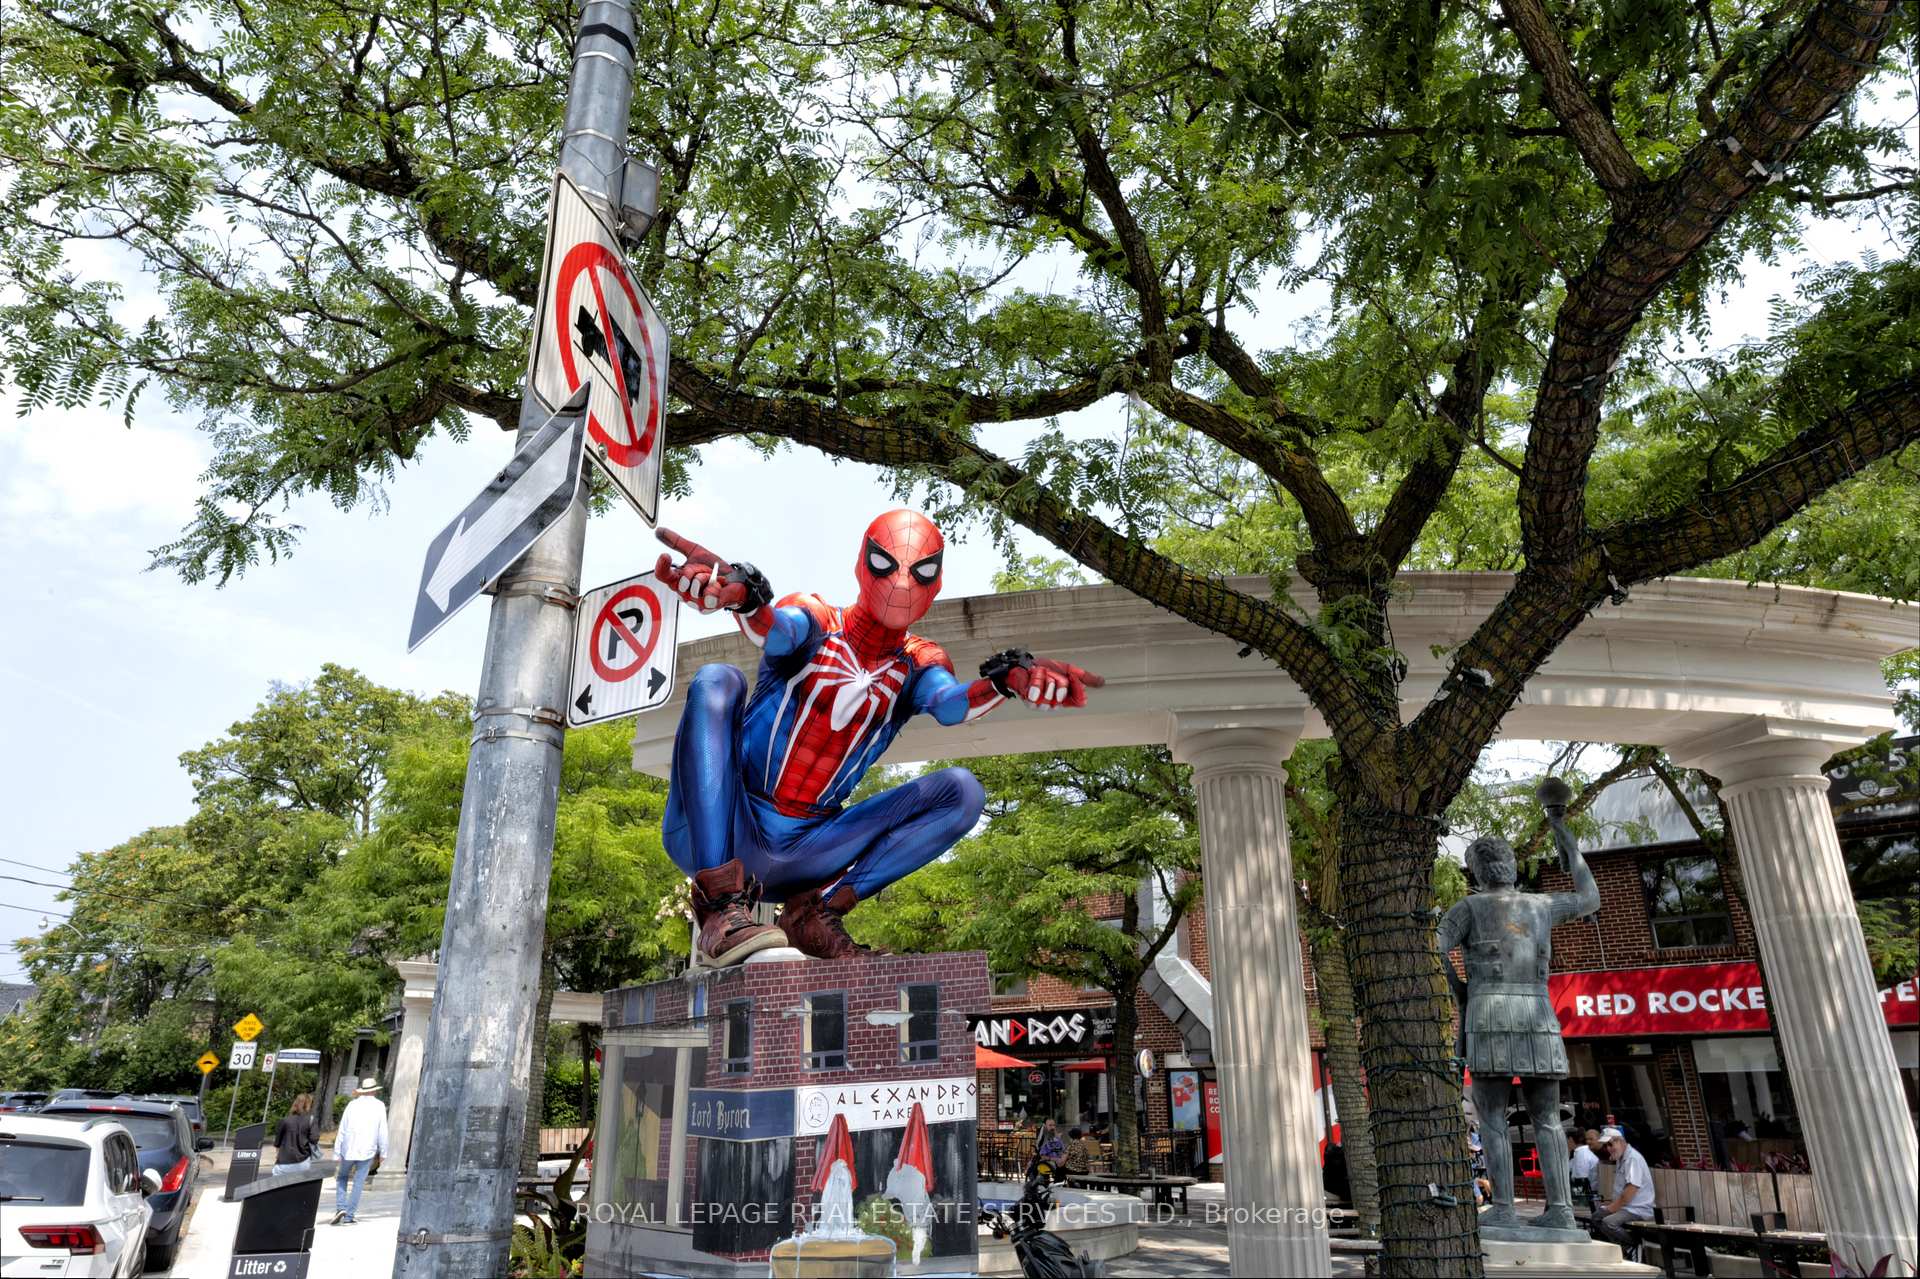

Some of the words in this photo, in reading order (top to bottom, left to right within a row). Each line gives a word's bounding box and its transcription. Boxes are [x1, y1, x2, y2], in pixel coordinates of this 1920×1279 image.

[1575, 993, 1636, 1017] RED
[1647, 986, 1767, 1015] ROCKE
[1877, 976, 1919, 1002] TE
[966, 1013, 1086, 1047] ANDROS
[232, 1053, 252, 1066] 30
[836, 1083, 976, 1105] ALEXANDRO
[691, 1100, 712, 1129] Lord
[716, 1100, 751, 1134] Byron
[872, 1108, 912, 1121] TAKE
[937, 1102, 965, 1116] OUT
[235, 1259, 272, 1276] Litter
